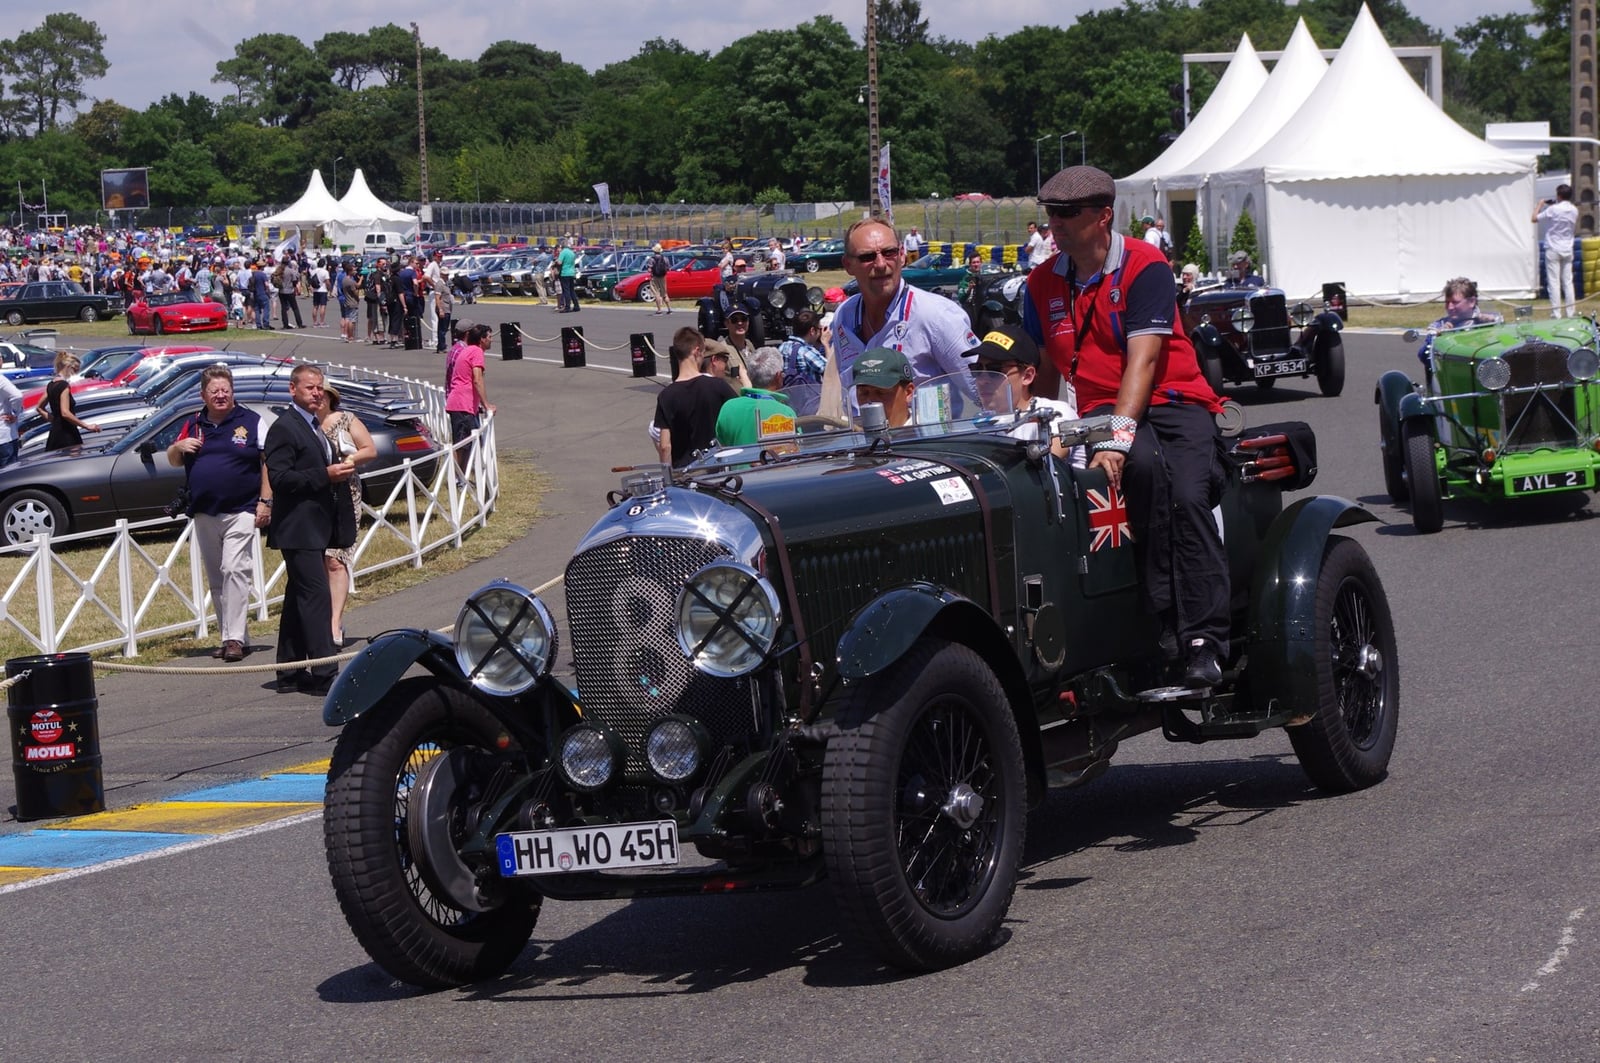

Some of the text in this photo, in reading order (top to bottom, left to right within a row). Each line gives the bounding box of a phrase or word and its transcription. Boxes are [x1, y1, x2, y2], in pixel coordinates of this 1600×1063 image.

[1256, 361, 1304, 375] KP 3634
[1523, 471, 1577, 491] AYL 2
[629, 505, 642, 516] B
[31, 721, 62, 731] MOTUL
[27, 745, 73, 759] MOTUL
[504, 827, 676, 870] D HH WO 45H
